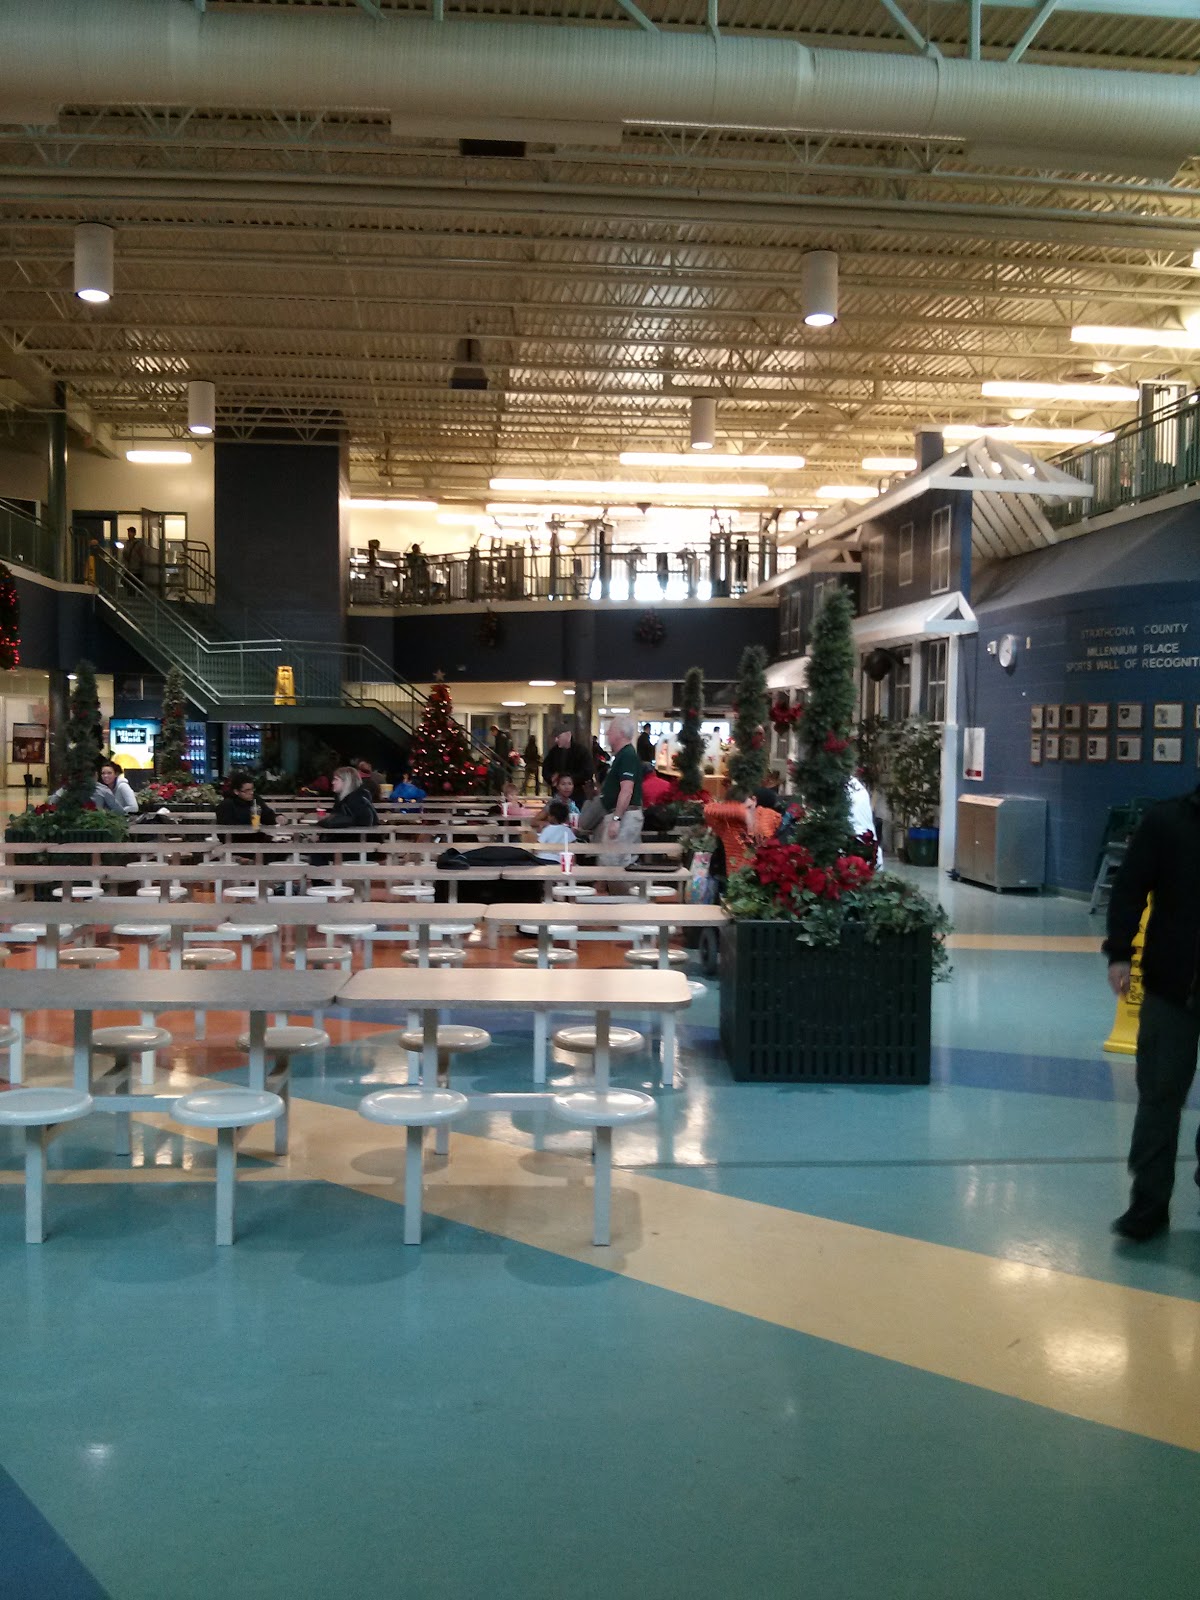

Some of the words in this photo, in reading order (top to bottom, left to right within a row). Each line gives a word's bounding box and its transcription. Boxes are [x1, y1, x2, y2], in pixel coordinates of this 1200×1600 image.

[1143, 623, 1189, 634] COUNTY
[1087, 645, 1138, 657] MILLENNIUM
[1143, 643, 1180, 654] PLACE
[1066, 661, 1093, 672] SPORTS
[1096, 660, 1119, 670] WALL
[1124, 660, 1137, 669] OF
